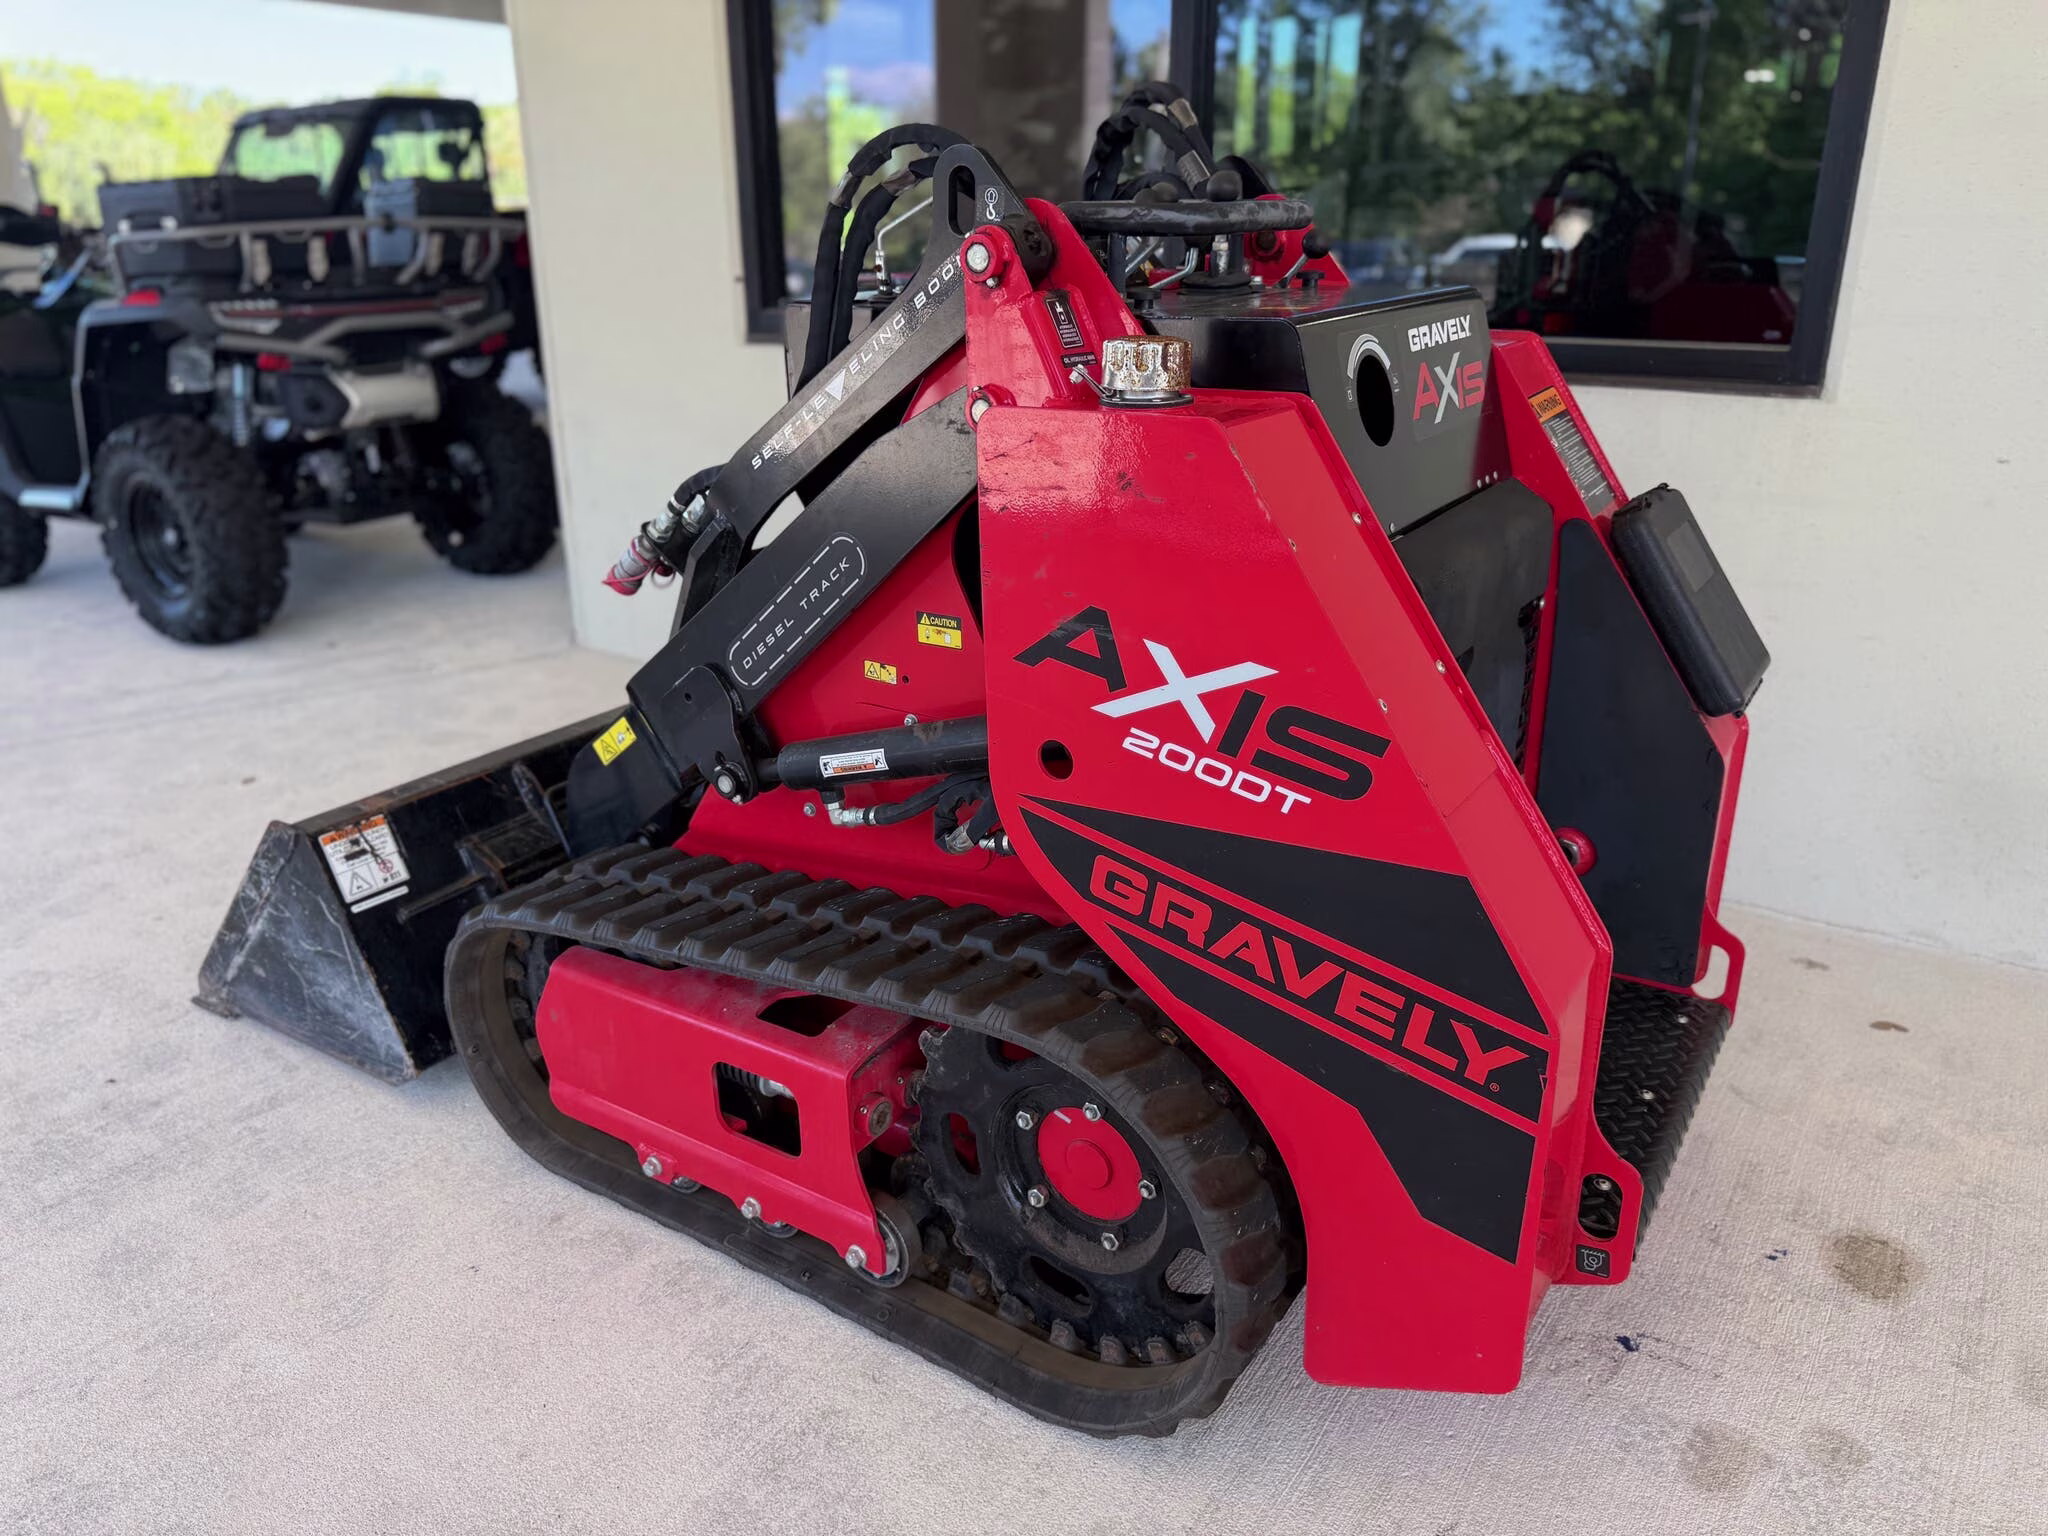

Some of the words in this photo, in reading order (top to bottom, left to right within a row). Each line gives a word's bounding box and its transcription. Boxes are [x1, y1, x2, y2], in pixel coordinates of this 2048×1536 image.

[914, 255, 962, 309] BOO
[1407, 314, 1472, 352] GRAVELY
[1412, 352, 1485, 424] AXIS
[743, 618, 794, 669] DIESEL
[800, 557, 850, 609] TRACK
[930, 616, 957, 628] CAUTION
[1012, 604, 1392, 800] AXIS
[1121, 727, 1312, 814] 200DT
[1089, 855, 1530, 1086] GRAVELY
